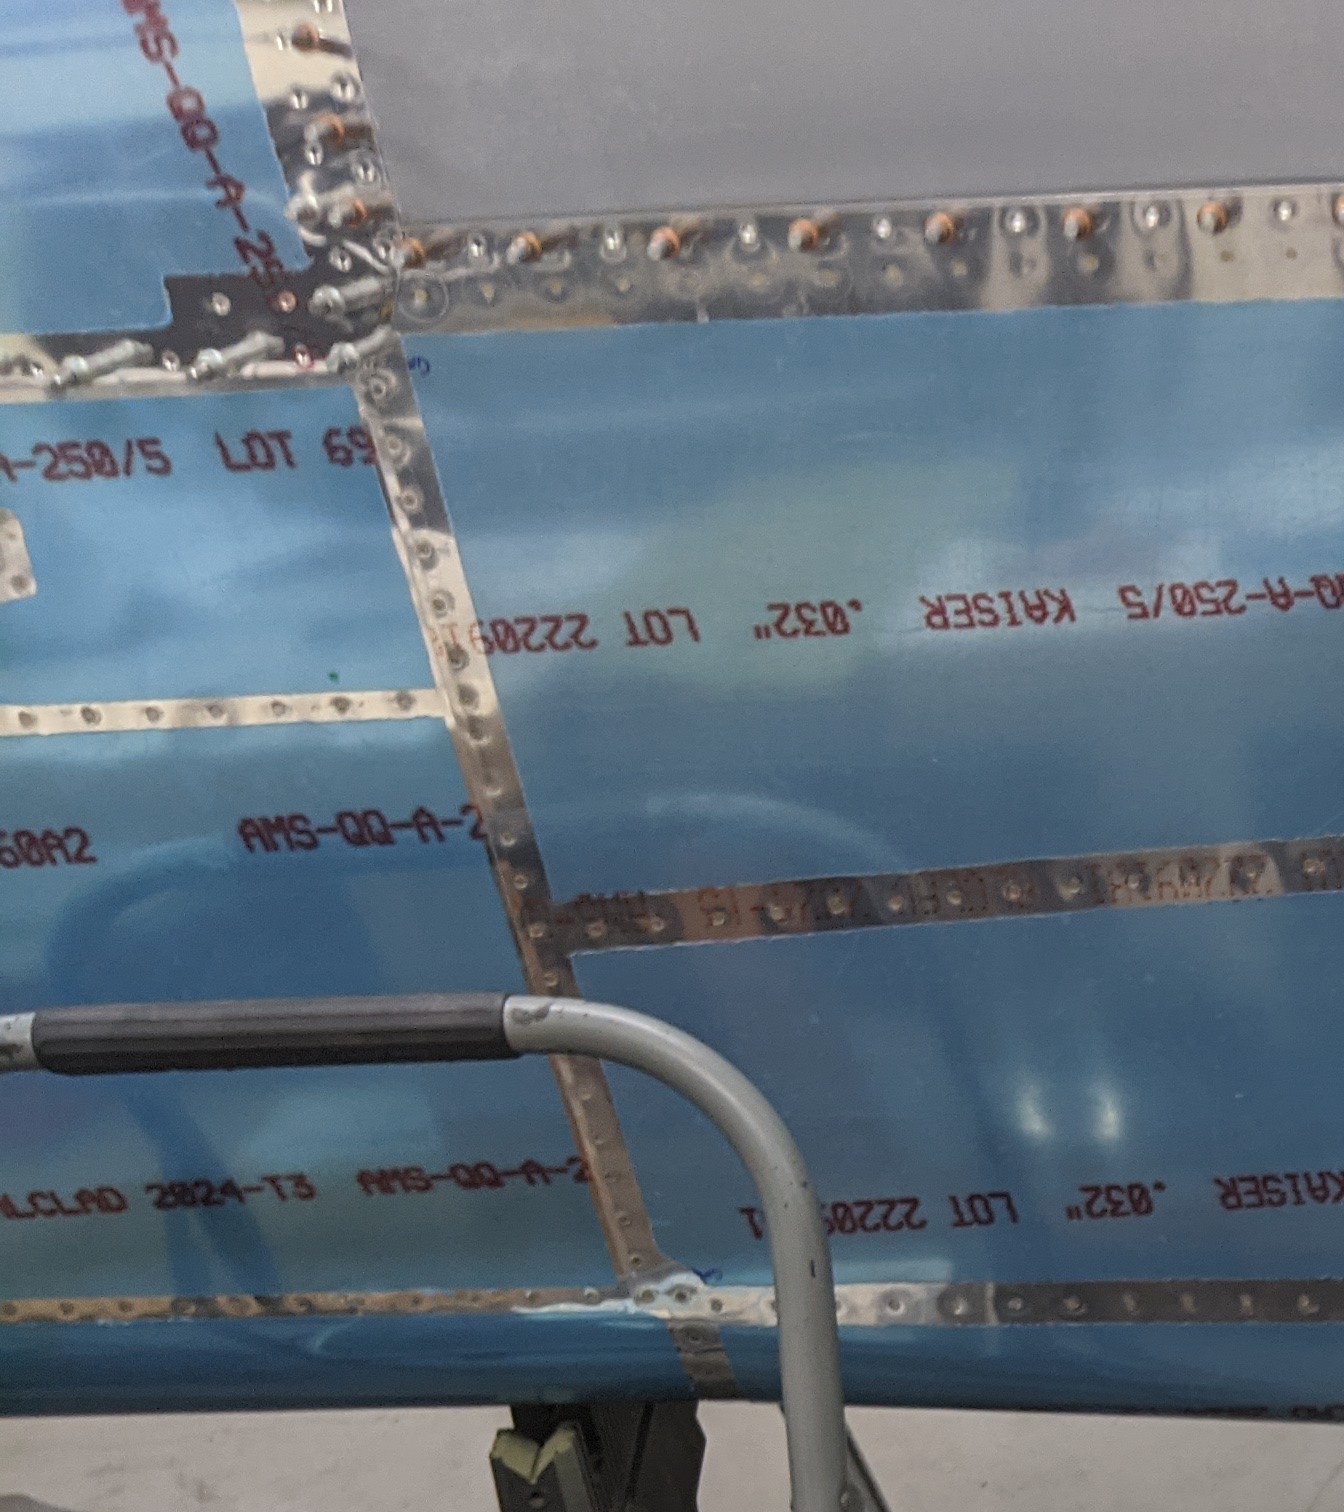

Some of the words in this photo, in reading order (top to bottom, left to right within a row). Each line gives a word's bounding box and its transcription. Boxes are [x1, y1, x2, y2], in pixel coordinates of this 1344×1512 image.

[214, 429, 297, 473] LOT
[623, 607, 700, 648] LOT
[918, 587, 1077, 631] KAISER
[146, 1173, 317, 1212] 2024-T3
[947, 1190, 1021, 1229] LOT
